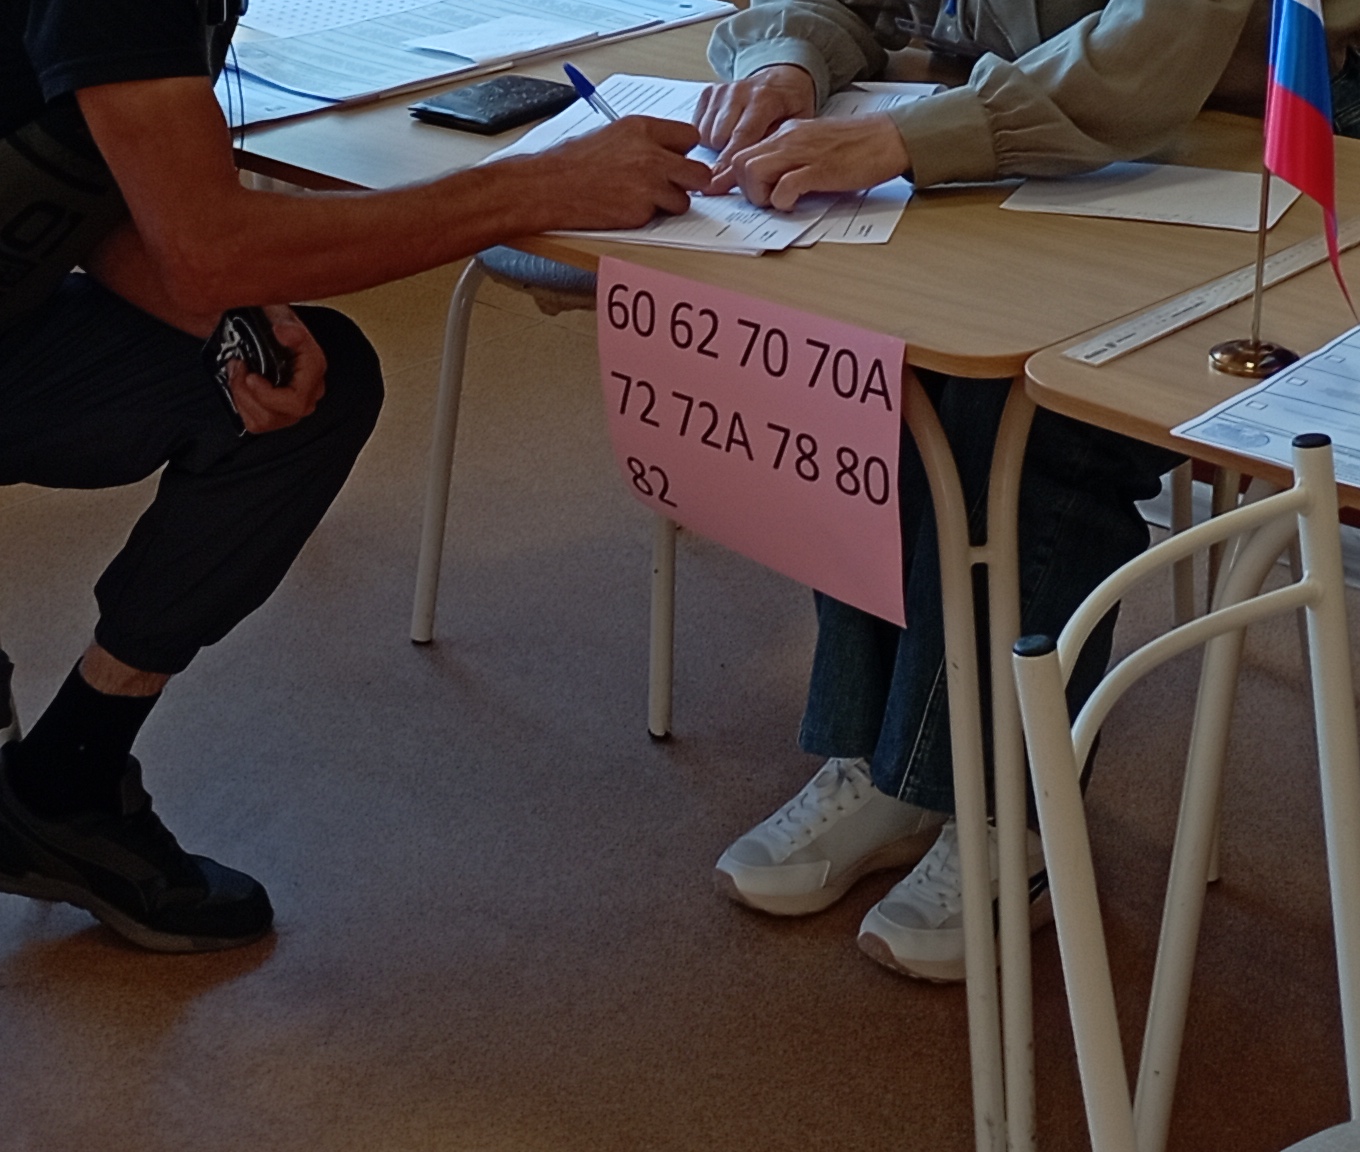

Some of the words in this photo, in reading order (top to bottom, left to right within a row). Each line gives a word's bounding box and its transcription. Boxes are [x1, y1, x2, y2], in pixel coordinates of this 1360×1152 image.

[607, 283, 656, 338] 60
[670, 301, 719, 359] 62
[737, 318, 789, 378] 70
[610, 370, 660, 428] 72
[766, 422, 820, 482] 78
[835, 446, 890, 506] 80
[626, 455, 679, 509] 82
